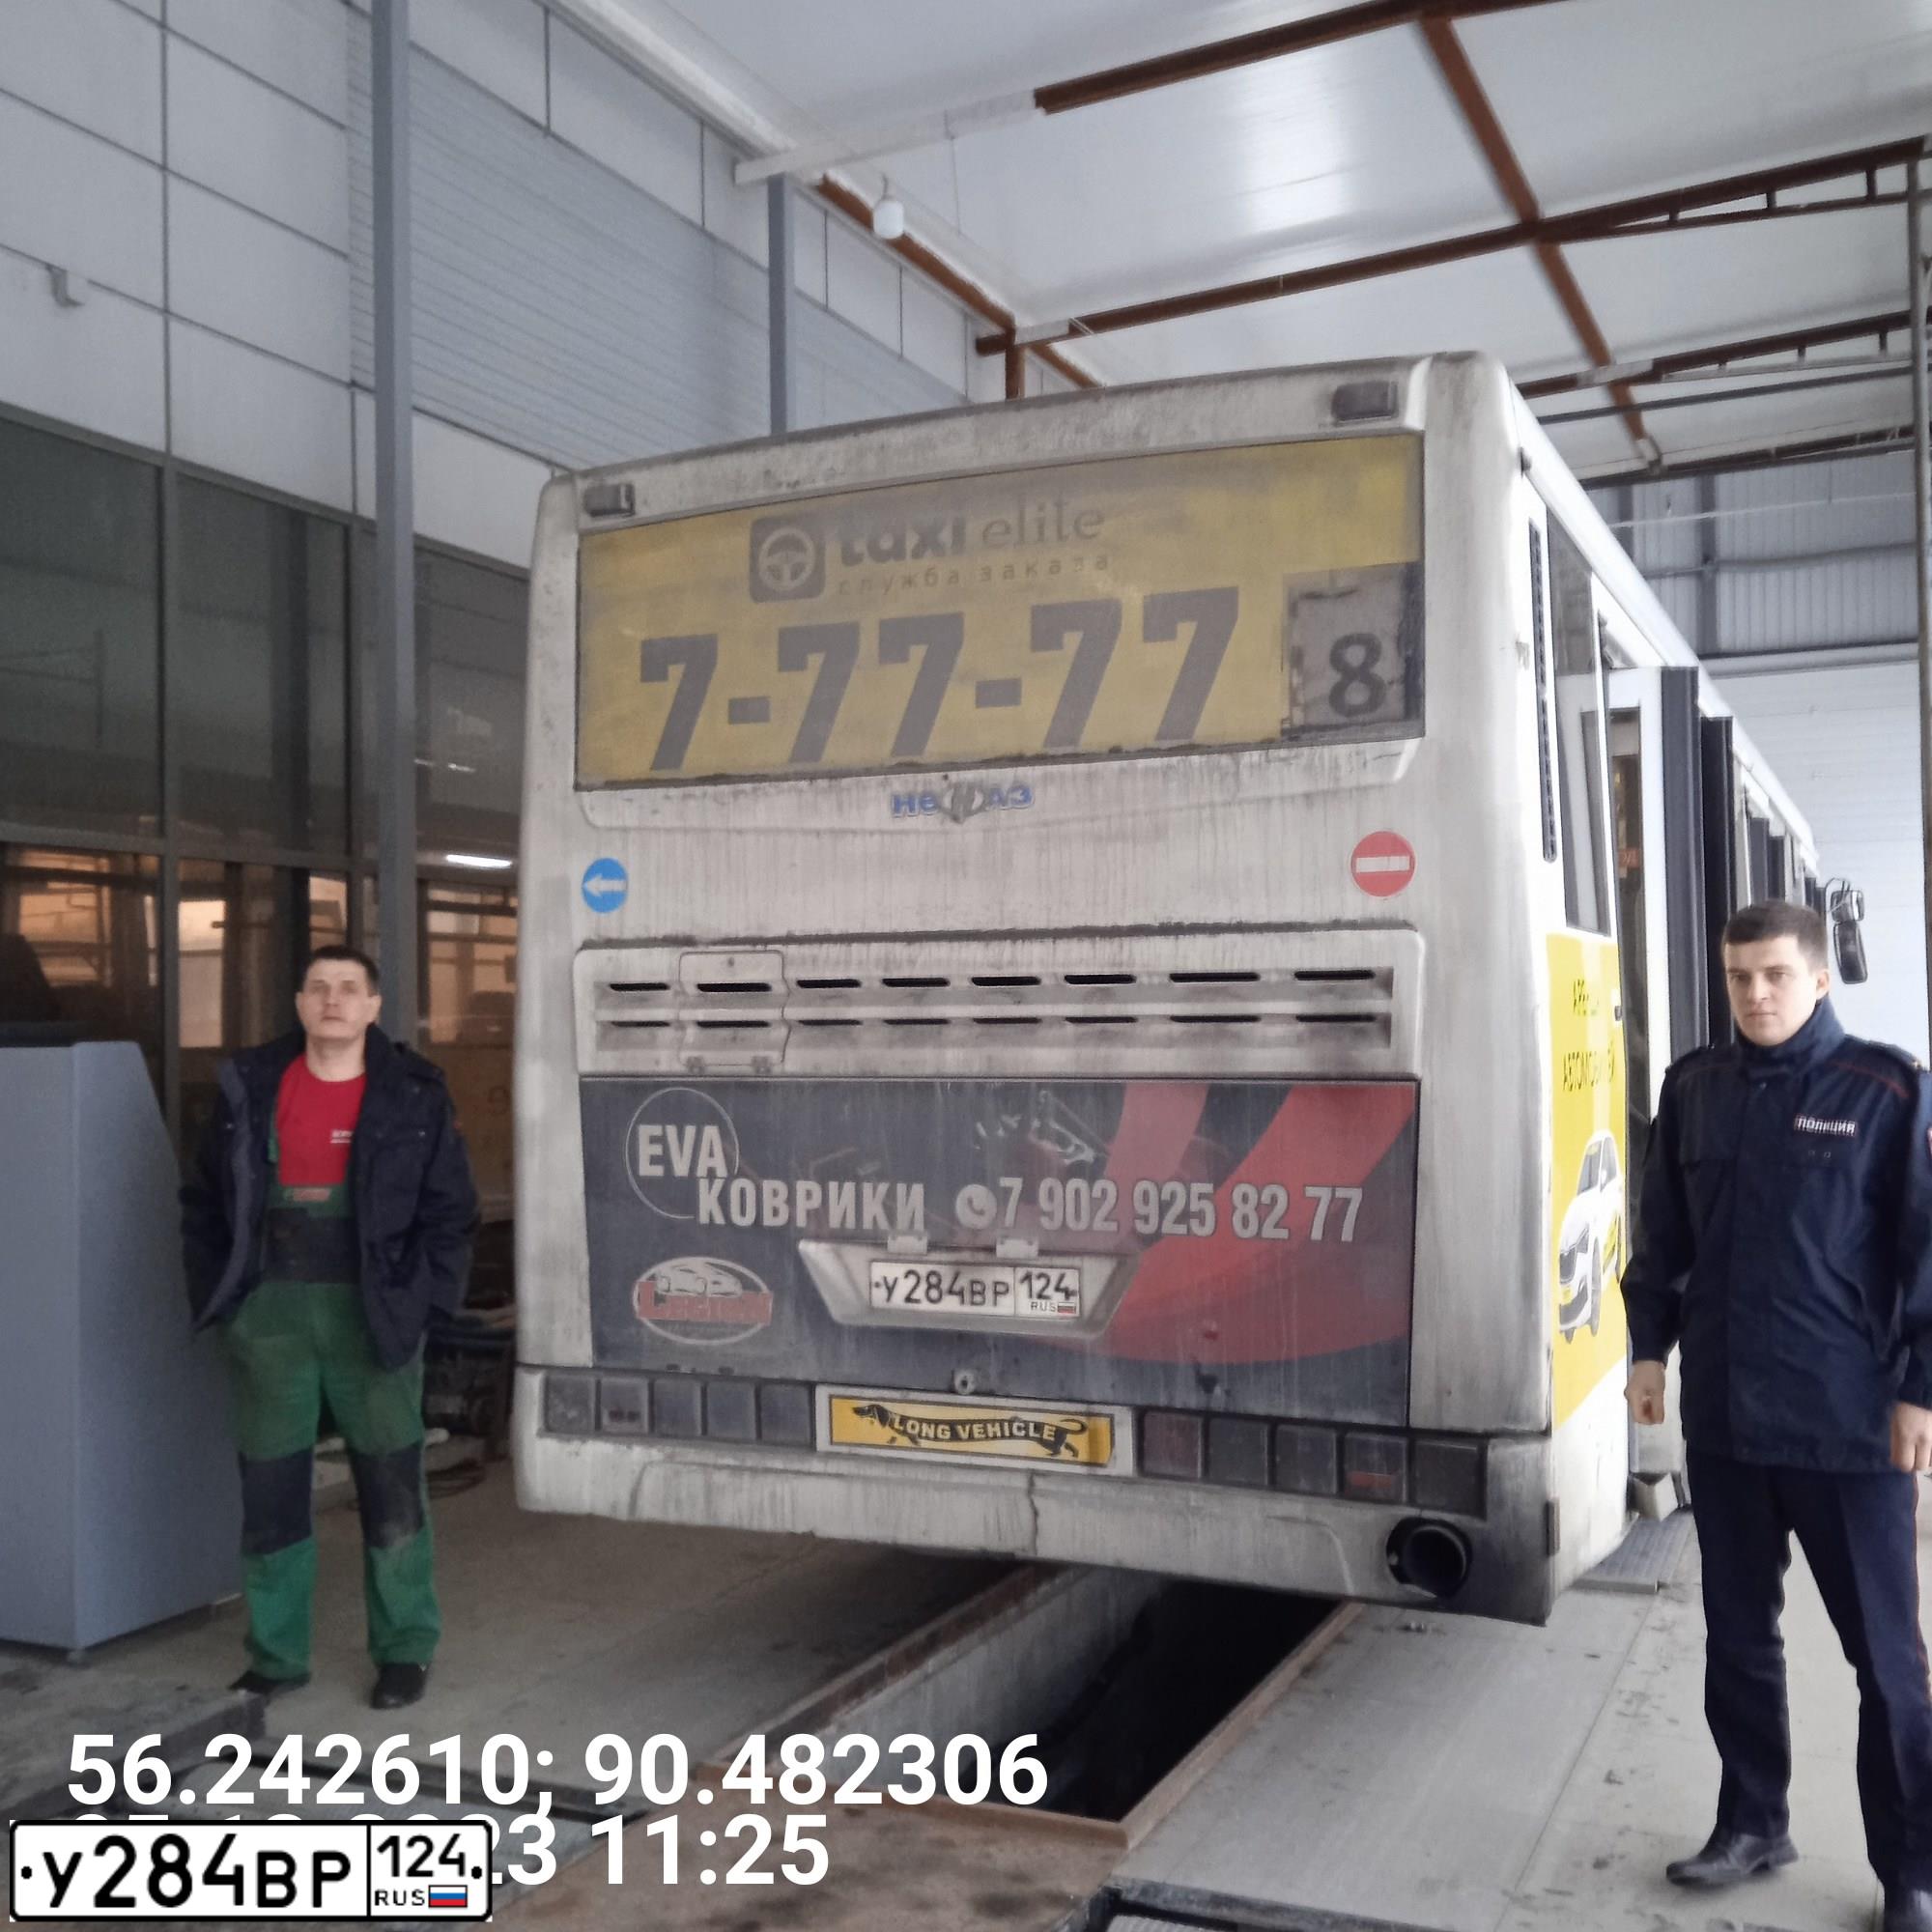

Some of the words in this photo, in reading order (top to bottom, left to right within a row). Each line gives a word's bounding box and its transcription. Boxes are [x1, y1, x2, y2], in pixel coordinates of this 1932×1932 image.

[837, 514, 966, 567] taxi
[981, 493, 1106, 550] elite
[838, 568, 960, 596] служба
[980, 554, 1109, 582] заказа
[639, 586, 1240, 771] 7-77-77
[1329, 633, 1386, 718] 8
[639, 1124, 727, 1178] EVA
[697, 1178, 924, 1231] КОВРИКИ
[999, 1177, 1023, 1228] 7
[1038, 1178, 1119, 1232] 902
[1132, 1179, 1216, 1237] 925
[1232, 1183, 1290, 1239] 82
[1305, 1186, 1363, 1242] 77
[882, 1269, 1009, 1306] У284ВР
[1020, 1271, 1072, 1301] 124
[1030, 1301, 1056, 1313] RUS
[895, 1415, 952, 1440] LONG
[956, 1422, 1056, 1441] VEHICLE
